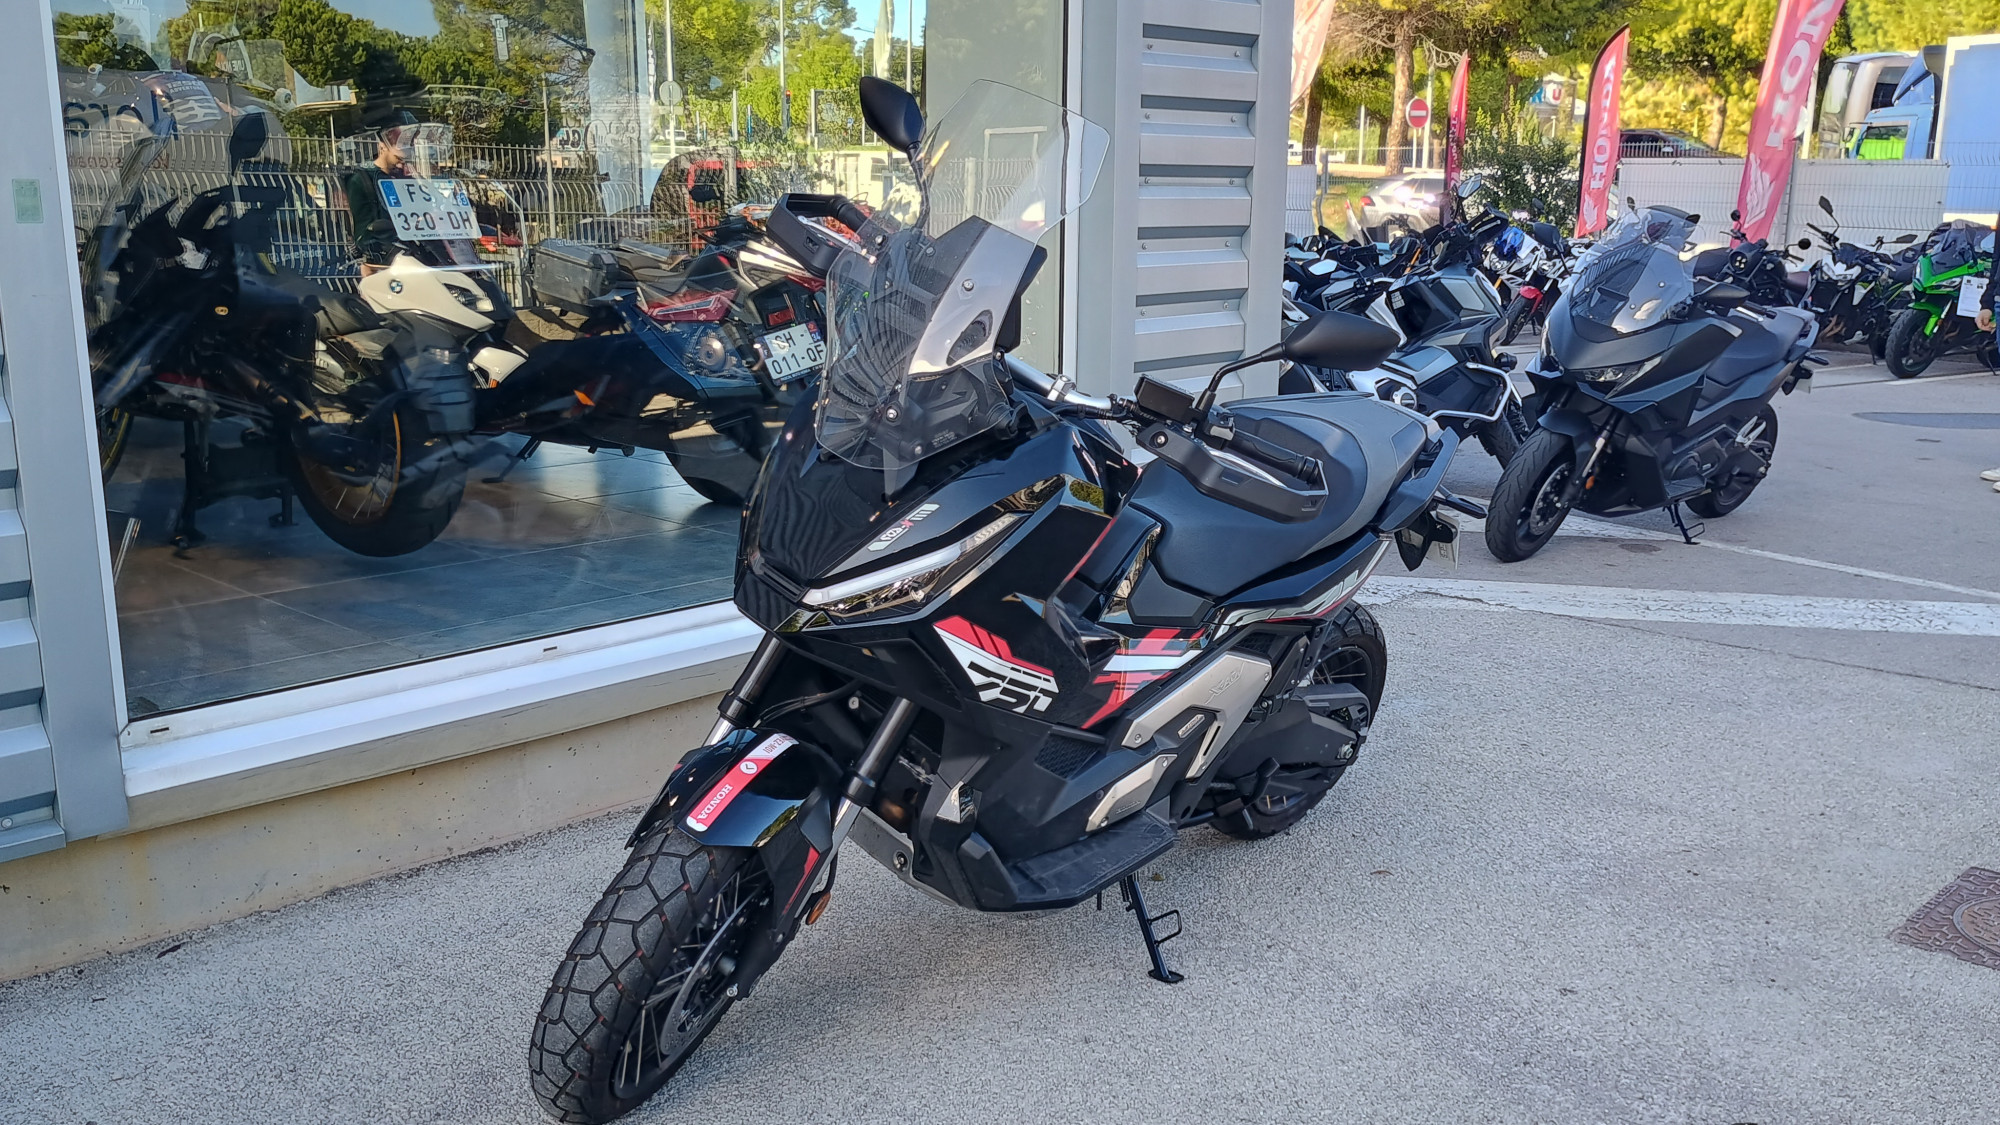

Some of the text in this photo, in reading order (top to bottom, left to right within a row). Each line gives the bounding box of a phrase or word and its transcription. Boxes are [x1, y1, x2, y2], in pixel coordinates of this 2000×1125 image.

[1766, 0, 1837, 150] HON
[1590, 56, 1616, 189] HONDA
[397, 211, 473, 231] 320-DH
[771, 343, 824, 375] 011-QF
[696, 784, 733, 820] HONDA
